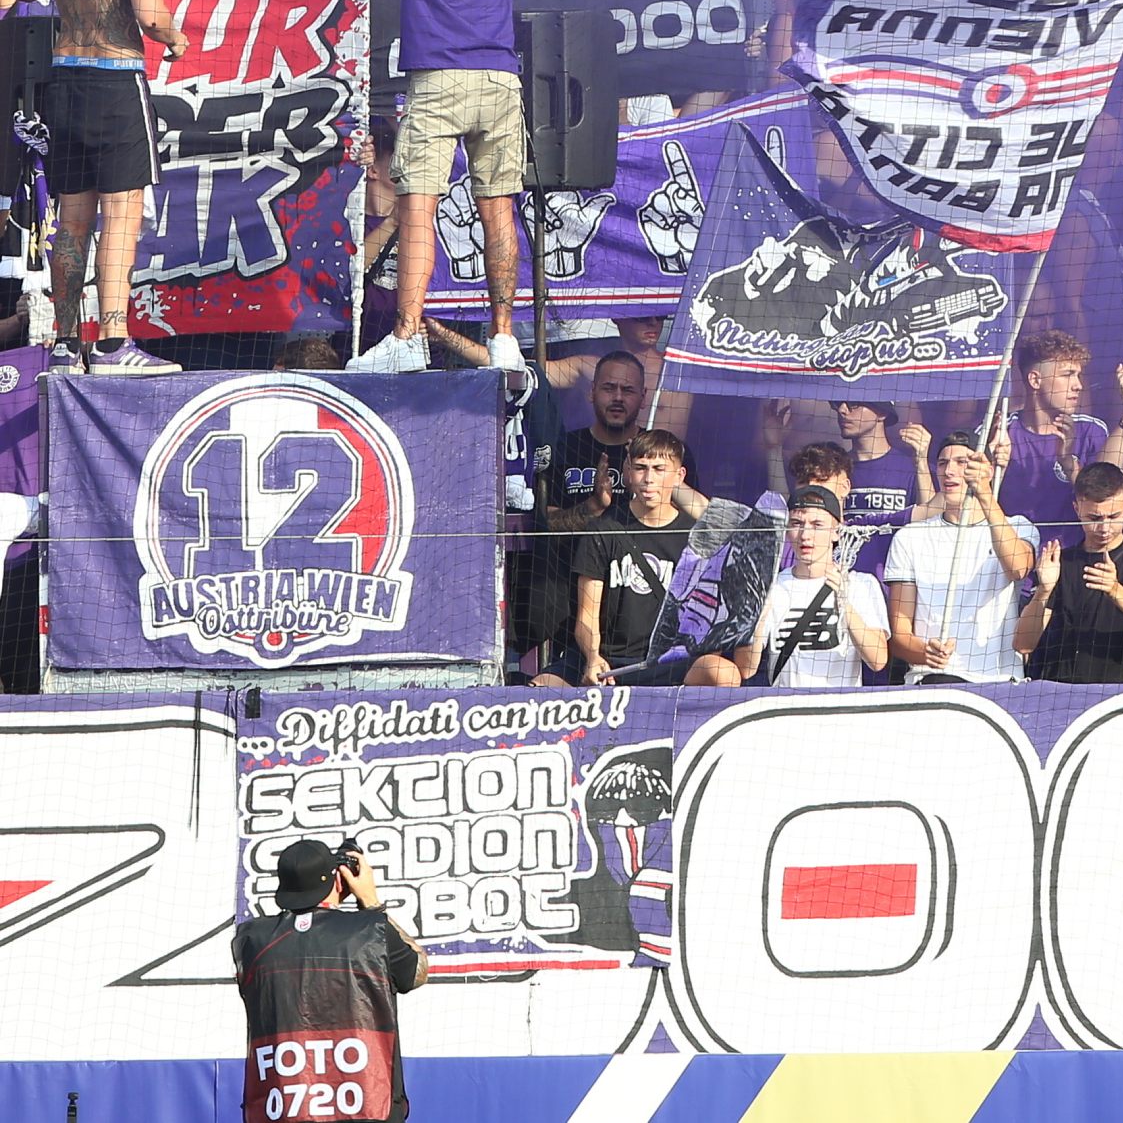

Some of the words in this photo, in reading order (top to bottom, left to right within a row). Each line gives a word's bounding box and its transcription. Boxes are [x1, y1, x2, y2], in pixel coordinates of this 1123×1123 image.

[136, 165, 290, 272] AK
[714, 318, 825, 358] Nothing
[815, 341, 871, 373] stop
[183, 431, 363, 578] 12
[864, 494, 906, 510] 1899
[153, 570, 297, 623] AUSTRIA
[303, 570, 397, 623] WIEN
[282, 705, 457, 755] Diffidati
[468, 704, 529, 734] con
[541, 692, 602, 728] noi
[244, 751, 570, 834] SEKTION
[255, 810, 575, 883] ADION
[254, 871, 581, 938] RBOT
[256, 1037, 369, 1081] FOTO
[265, 1081, 364, 1121] 0720
